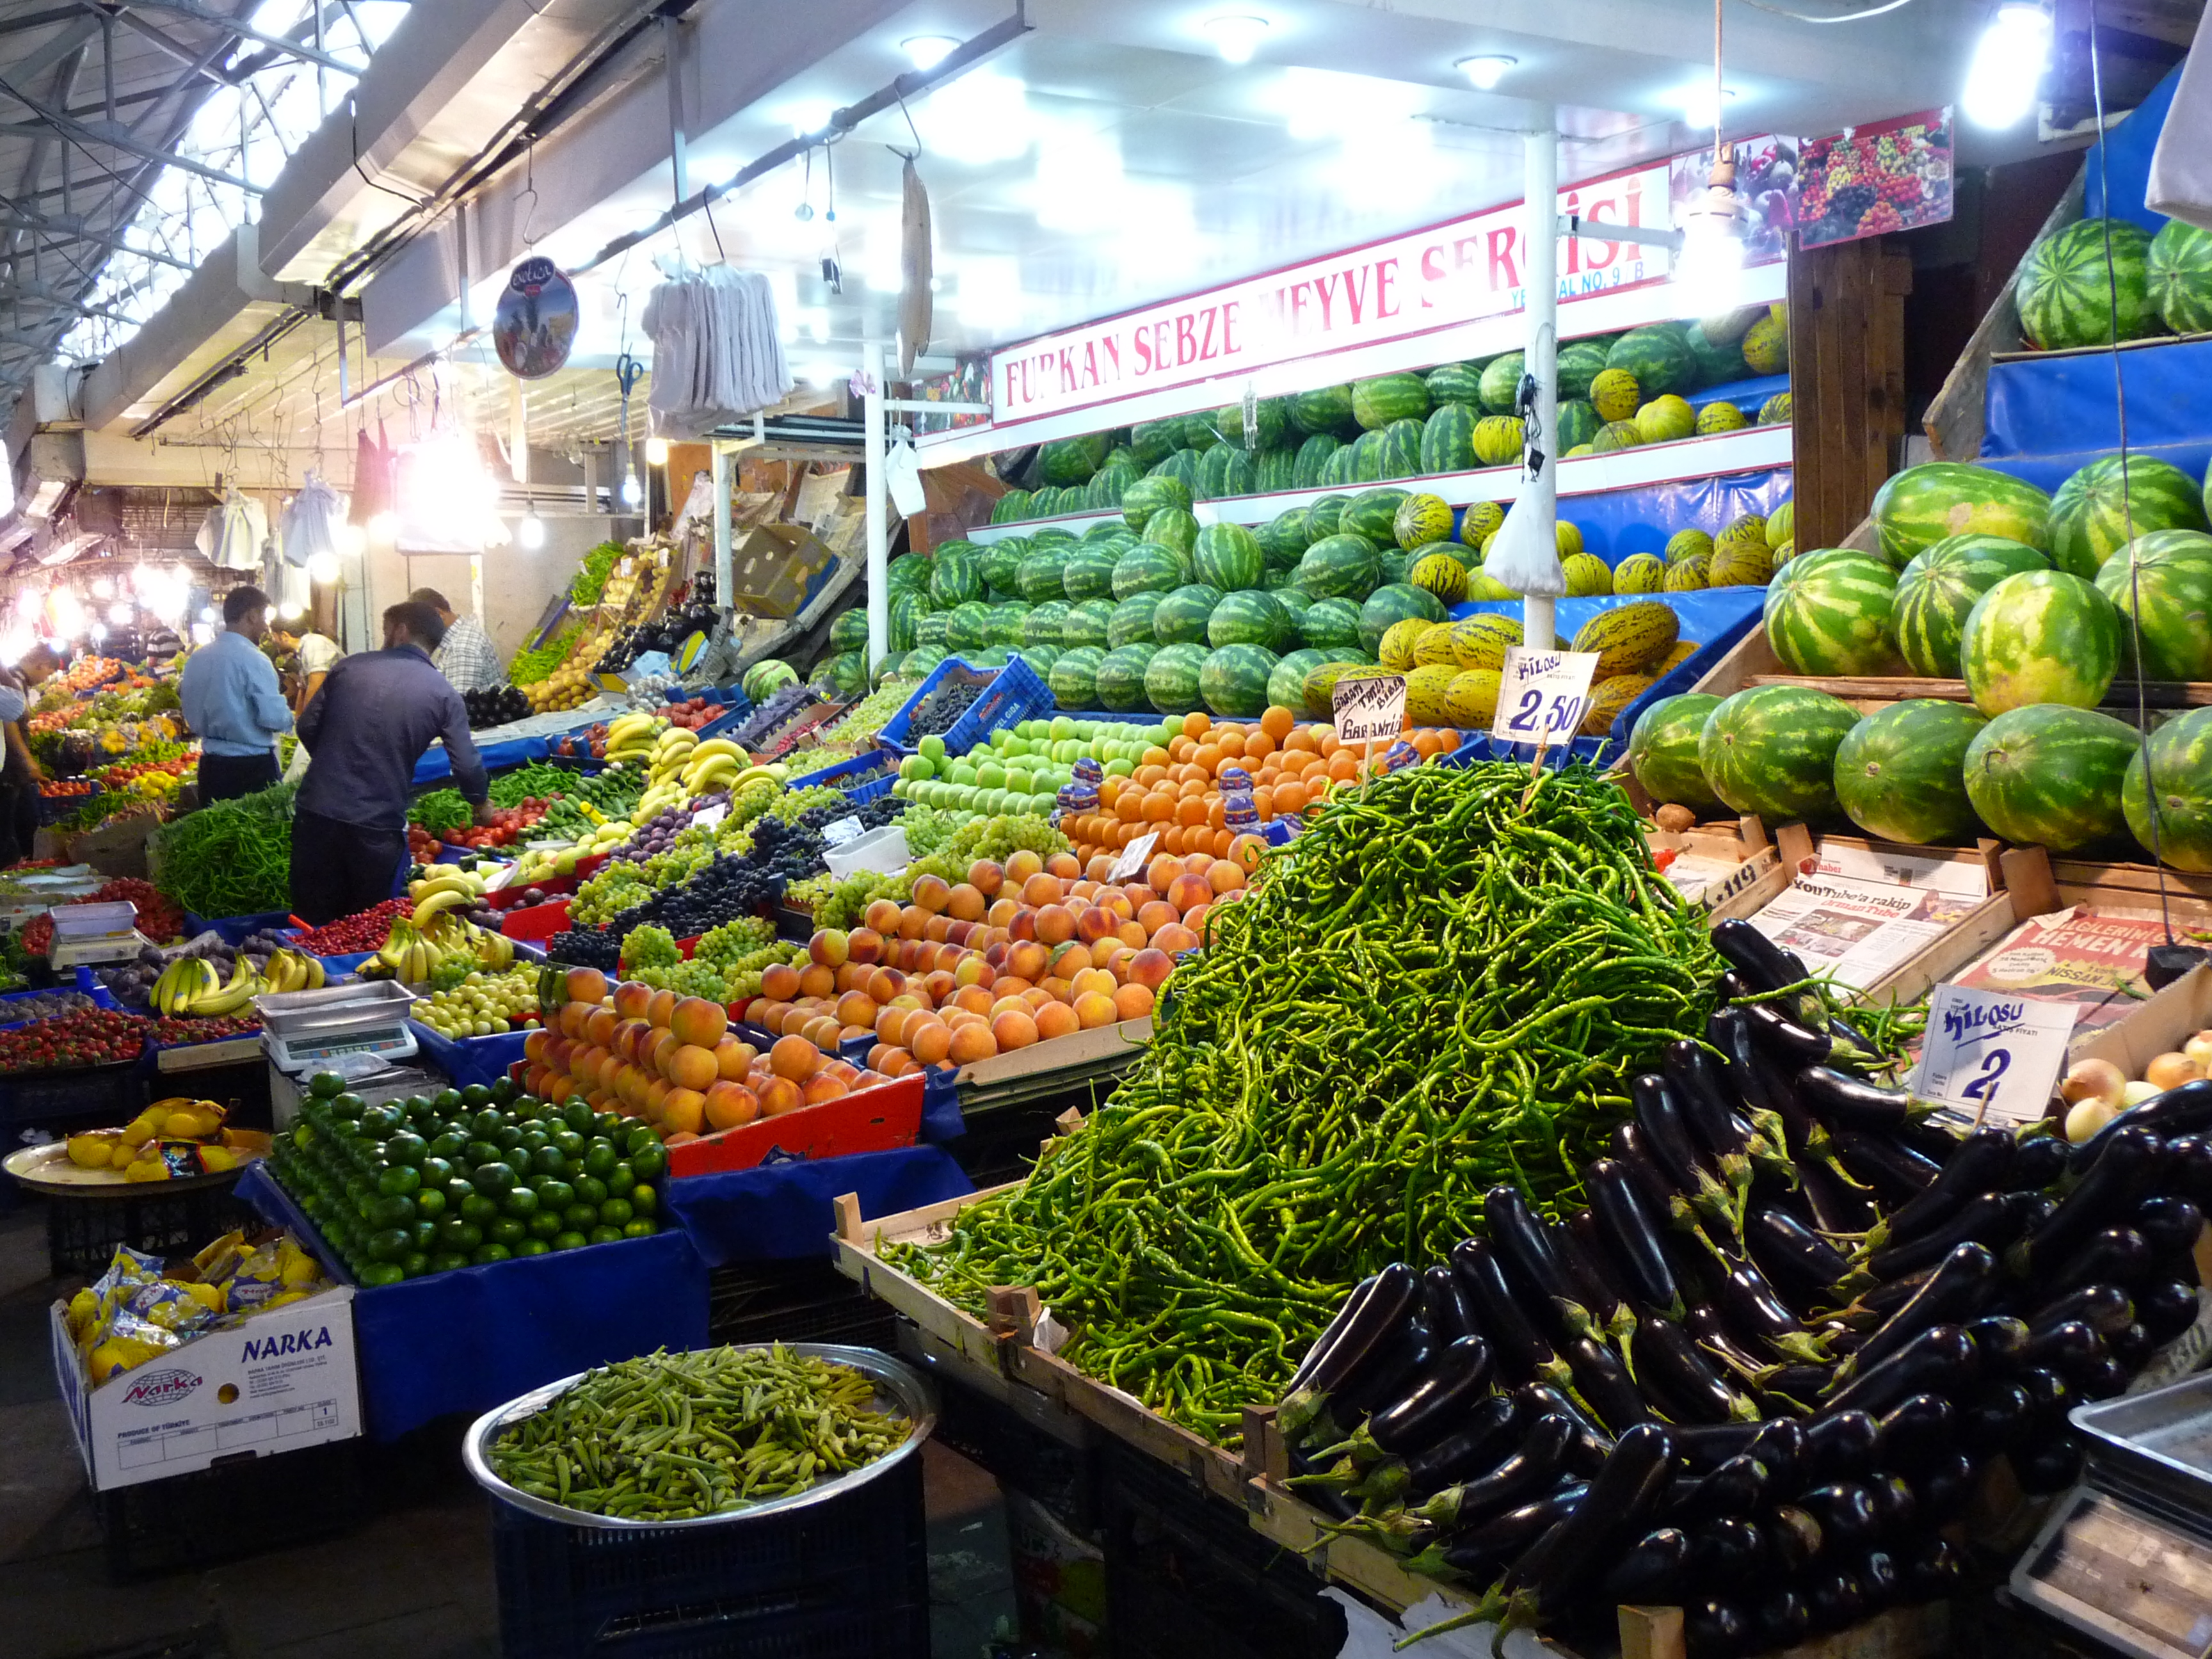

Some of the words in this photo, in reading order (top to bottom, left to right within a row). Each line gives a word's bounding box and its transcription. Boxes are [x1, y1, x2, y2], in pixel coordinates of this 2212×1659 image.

[1134, 301, 1242, 376] SEBZE
[1509, 689, 1580, 733] 2,50
[1869, 897, 1911, 911] rakip
[2030, 929, 2131, 955] HEMEN
[2045, 966, 2104, 984] NISSAN
[1944, 1003, 2024, 1041] KİLOSU
[1960, 1048, 2012, 1102] 2
[241, 1326, 333, 1364] NARKA
[121, 1375, 203, 1404] Narka
